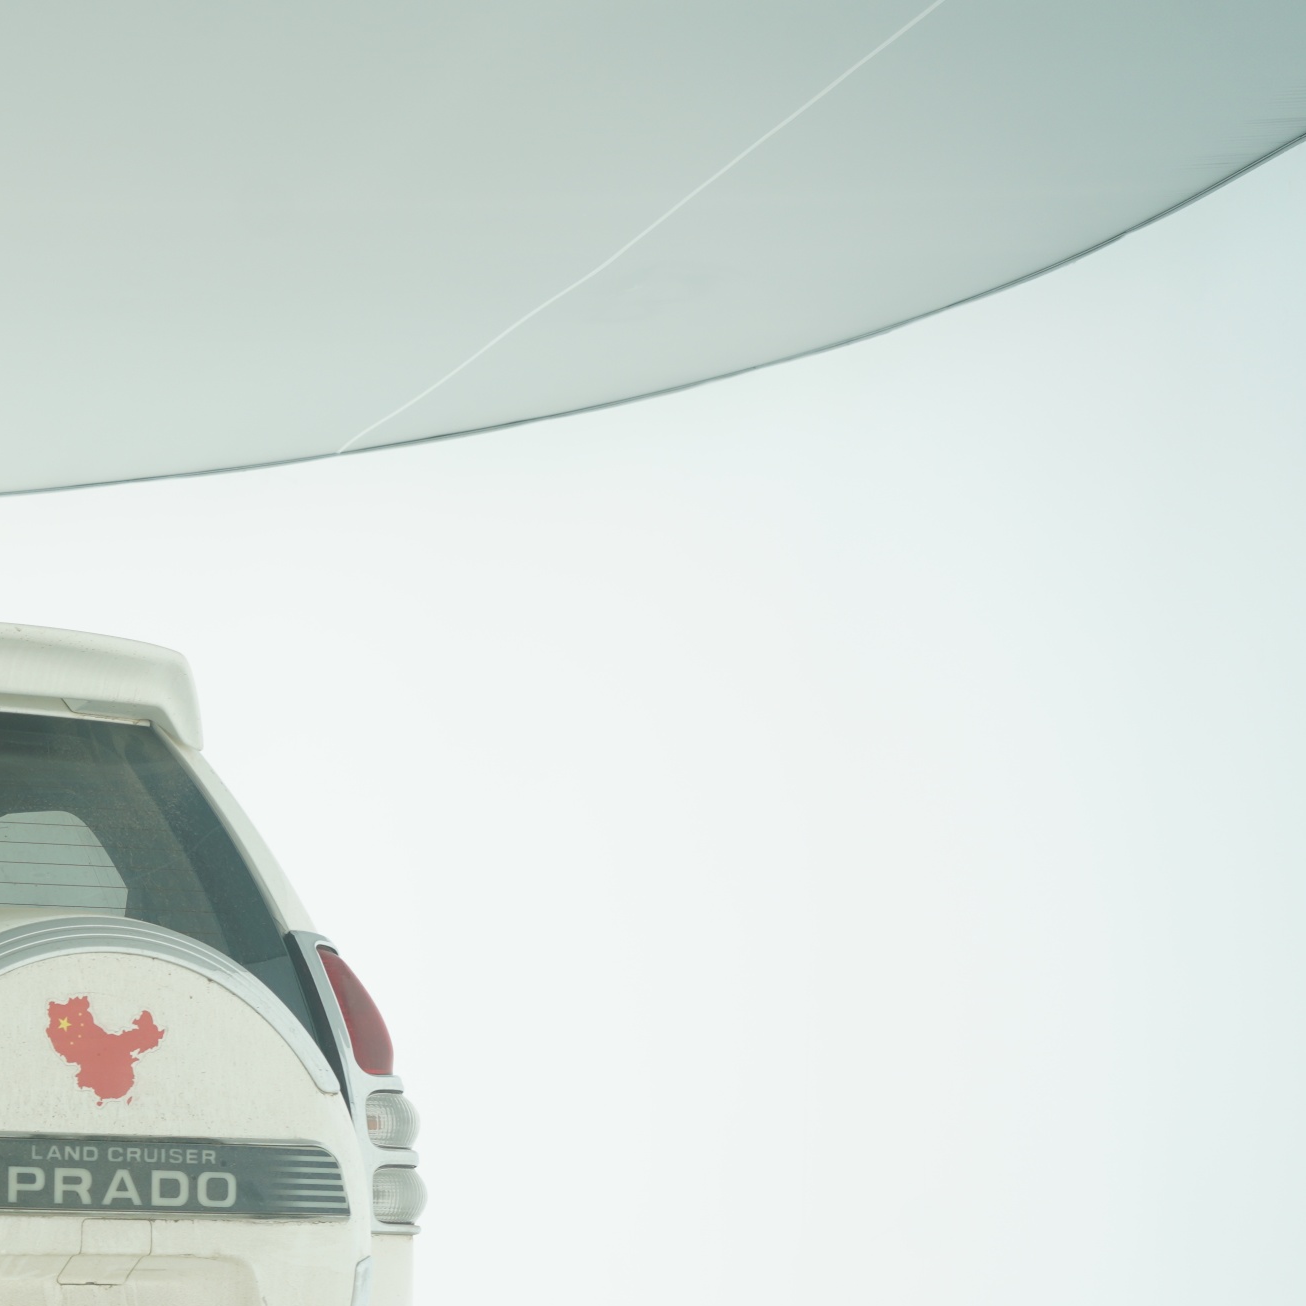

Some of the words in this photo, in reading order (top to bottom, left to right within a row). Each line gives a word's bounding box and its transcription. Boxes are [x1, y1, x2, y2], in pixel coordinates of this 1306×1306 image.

[31, 1145, 99, 1162] LAND
[107, 1147, 217, 1165] CRUISER
[7, 1166, 237, 1208] PRADO
